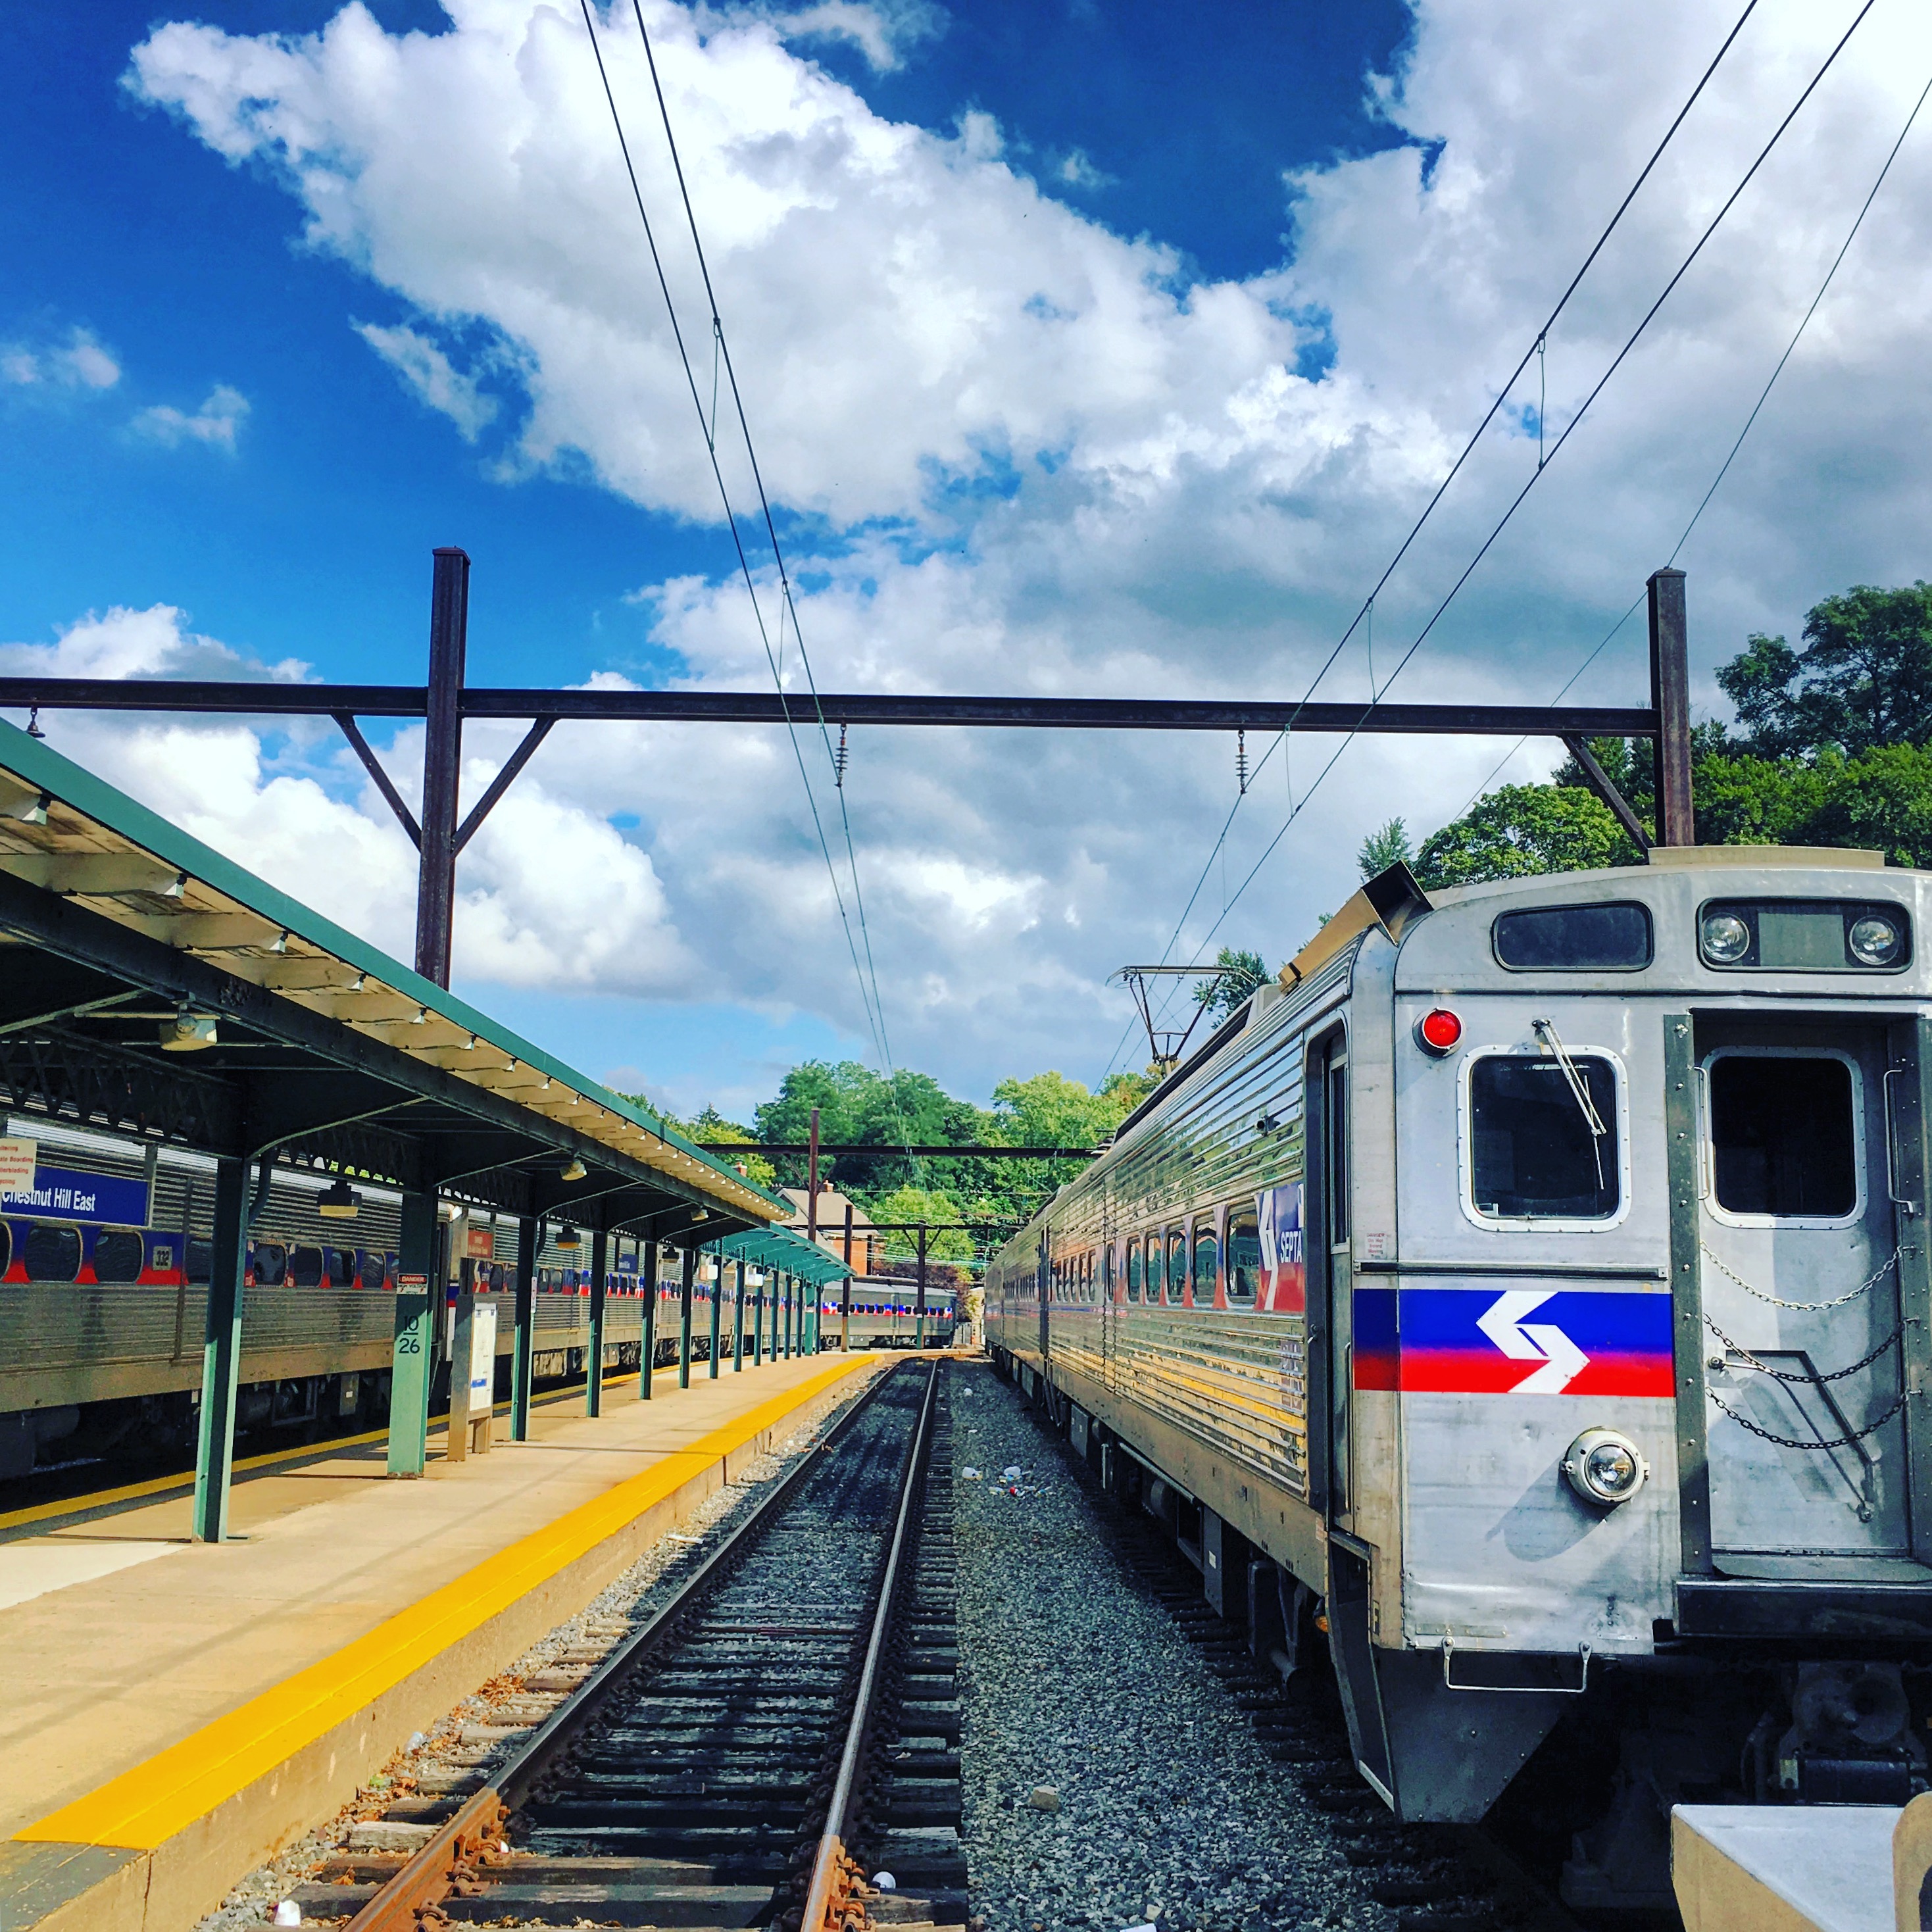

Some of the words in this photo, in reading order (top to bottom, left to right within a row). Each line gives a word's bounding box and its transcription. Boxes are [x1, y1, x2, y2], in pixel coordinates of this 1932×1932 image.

[2, 1188, 52, 1207] Chestnut
[53, 1187, 72, 1209] Hill
[73, 1190, 96, 1212] East
[1280, 1231, 1302, 1264] SEPTA
[404, 1316, 419, 1331] 10
[399, 1337, 420, 1354] 26
